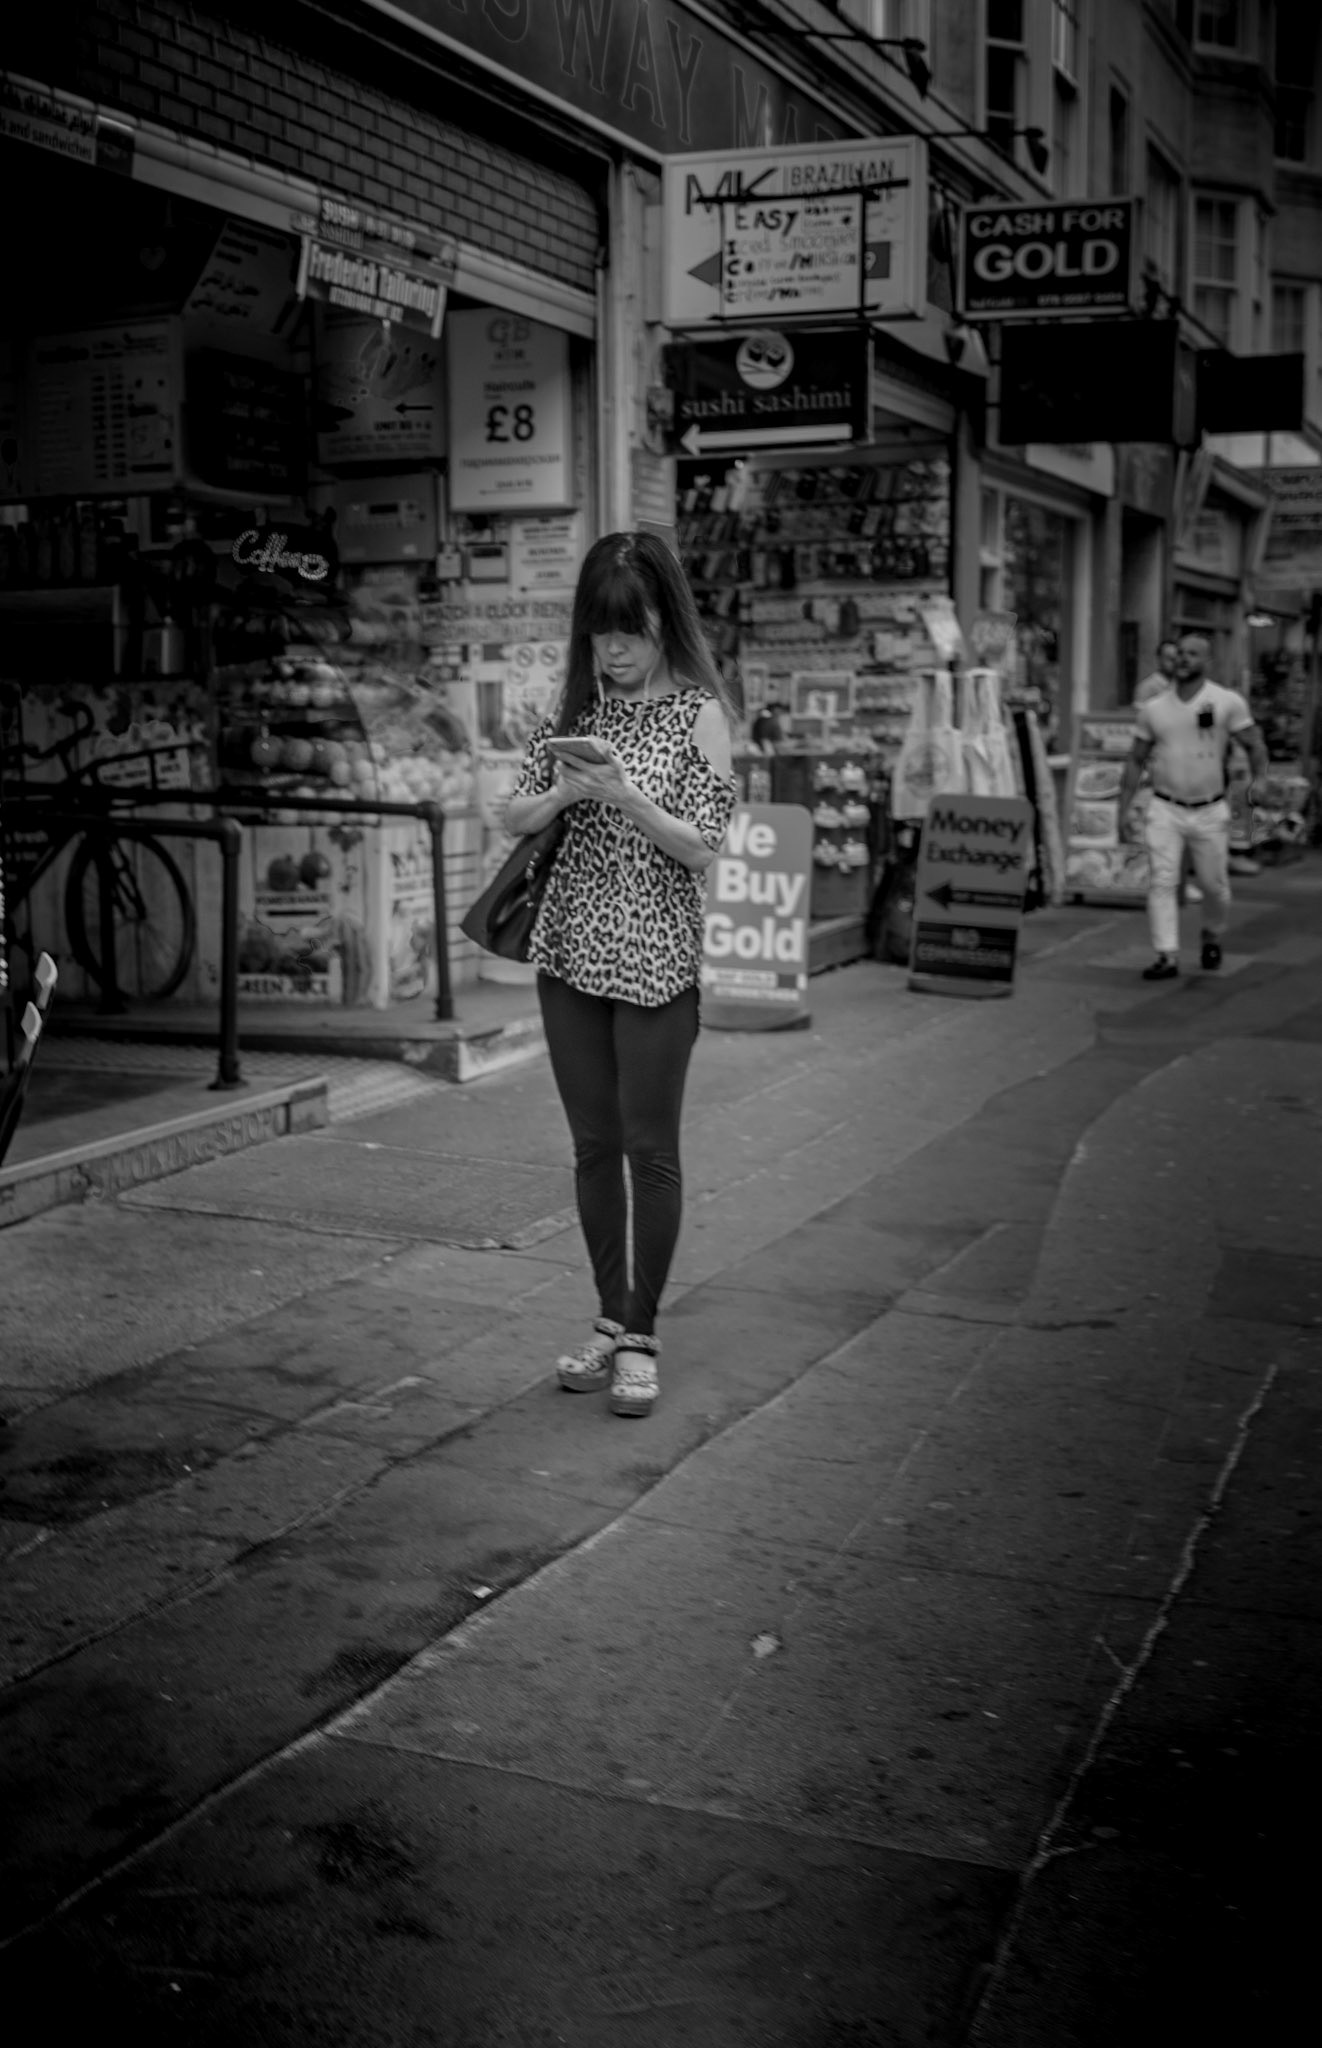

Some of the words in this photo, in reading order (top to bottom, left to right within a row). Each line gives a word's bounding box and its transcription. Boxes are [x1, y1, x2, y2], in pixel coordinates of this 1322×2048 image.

[449, 0, 703, 145] WAY
[969, 212, 1056, 239] CASH
[1061, 207, 1126, 233] FOR
[309, 244, 379, 297] Frederick
[379, 264, 437, 318] Tailoring
[973, 237, 1121, 283] GOLD
[679, 389, 746, 421] sushi
[751, 379, 853, 414] sashimi
[485, 402, 537, 443] £8
[232, 529, 304, 573] Coffee
[931, 810, 1025, 842] Money
[927, 842, 1022, 874] Exchange
[716, 857, 804, 917] Buy
[703, 913, 804, 962] Gold
